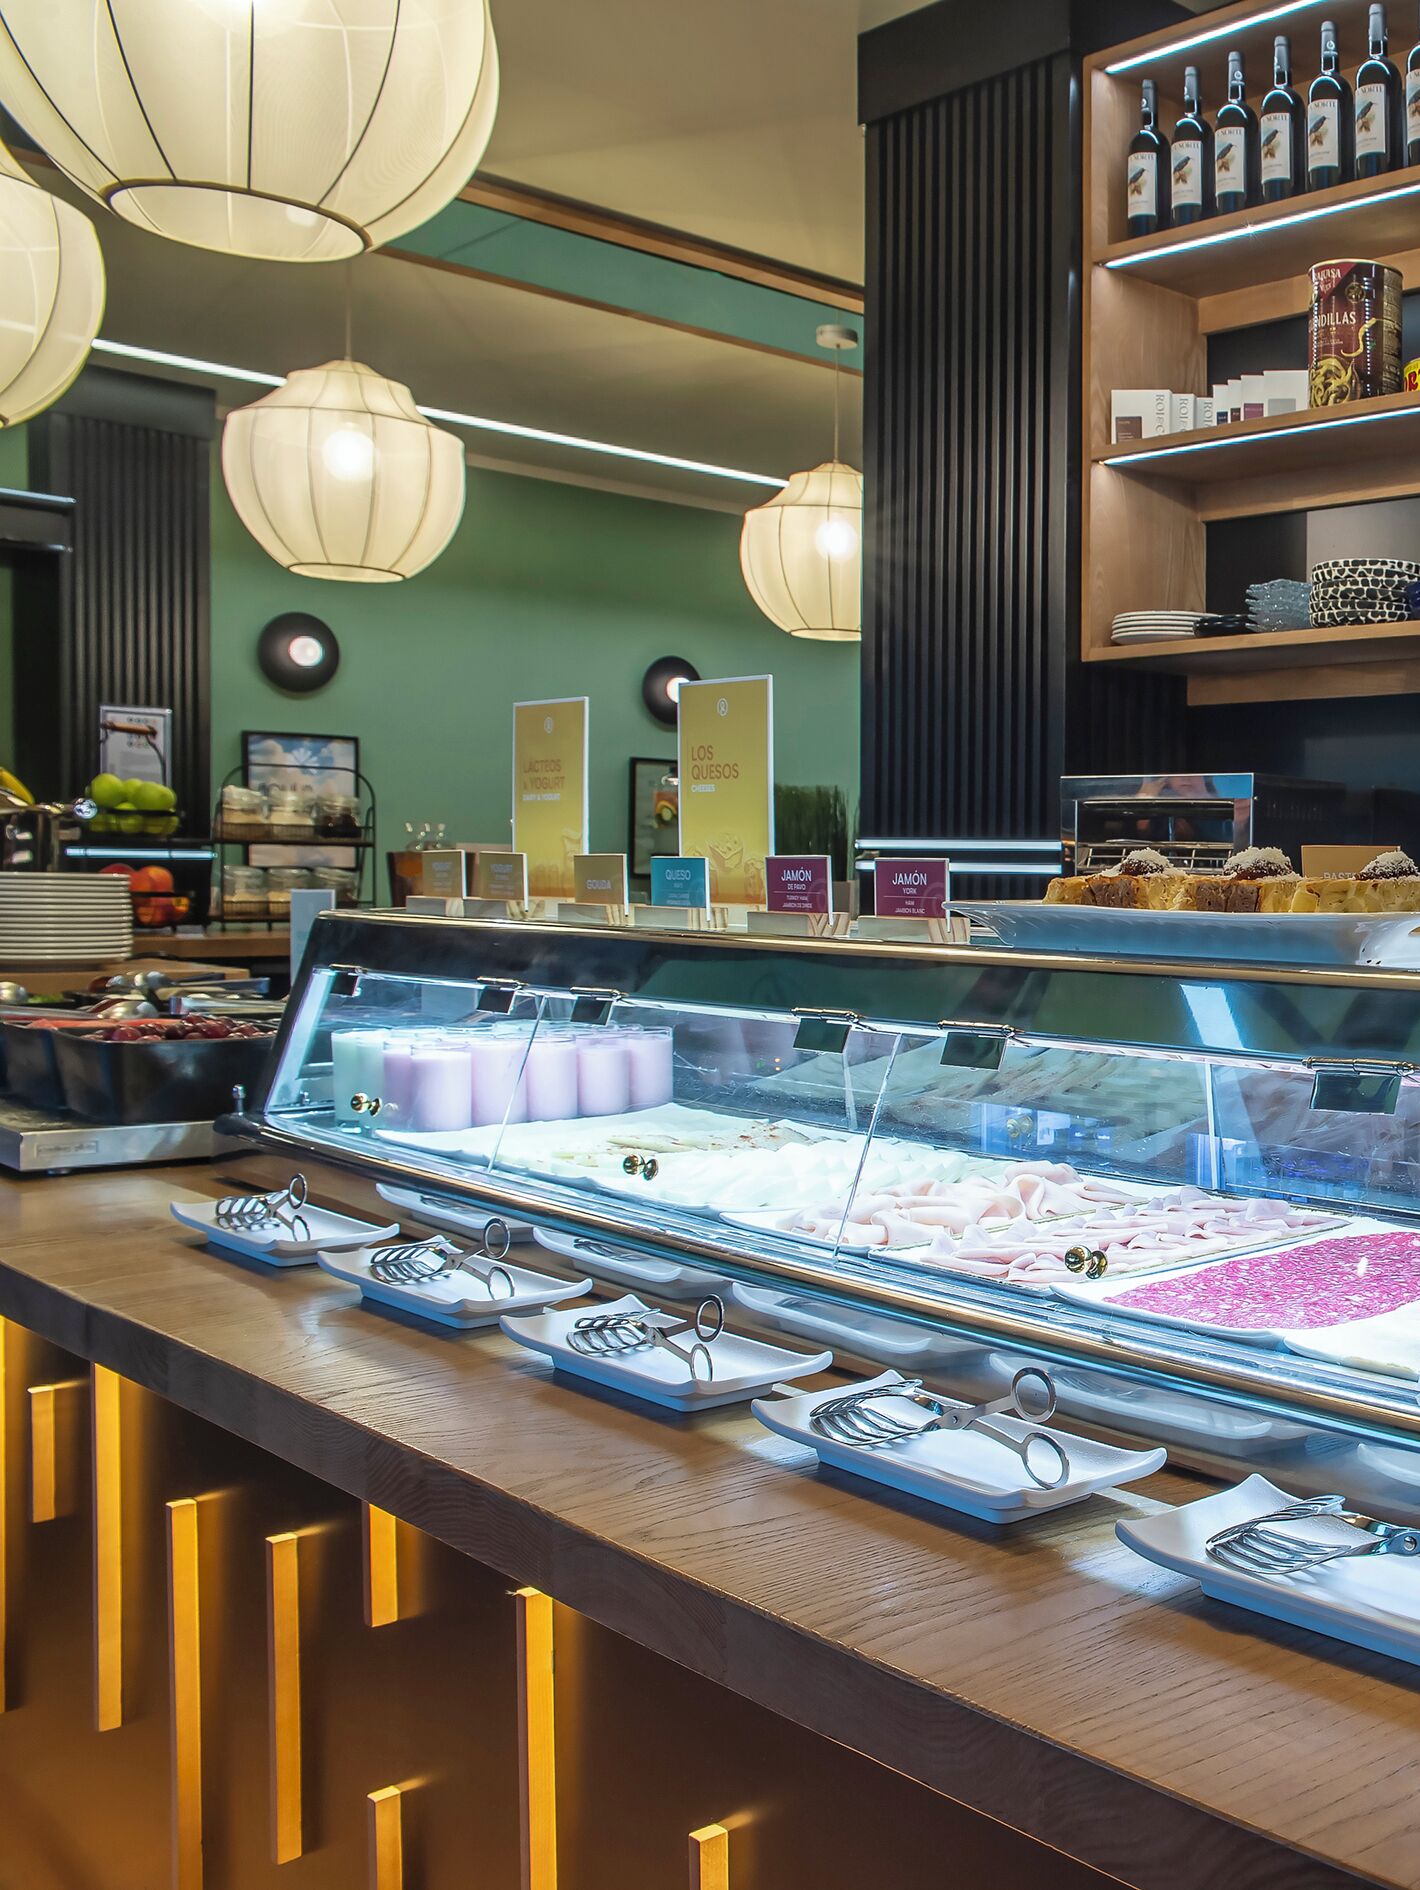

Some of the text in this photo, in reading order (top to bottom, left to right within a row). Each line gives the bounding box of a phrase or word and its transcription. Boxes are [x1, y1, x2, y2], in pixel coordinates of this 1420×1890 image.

[691, 744, 714, 762] LOS
[691, 762, 739, 781] QUESOS
[529, 775, 565, 790] YOGURT
[665, 869, 692, 881] QUESO
[780, 866, 812, 882] JAMÓN
[891, 869, 928, 886] JAMÓN
[586, 879, 612, 890] GOUDA
[794, 883, 807, 891] PAVO
[902, 887, 917, 895] YORK
